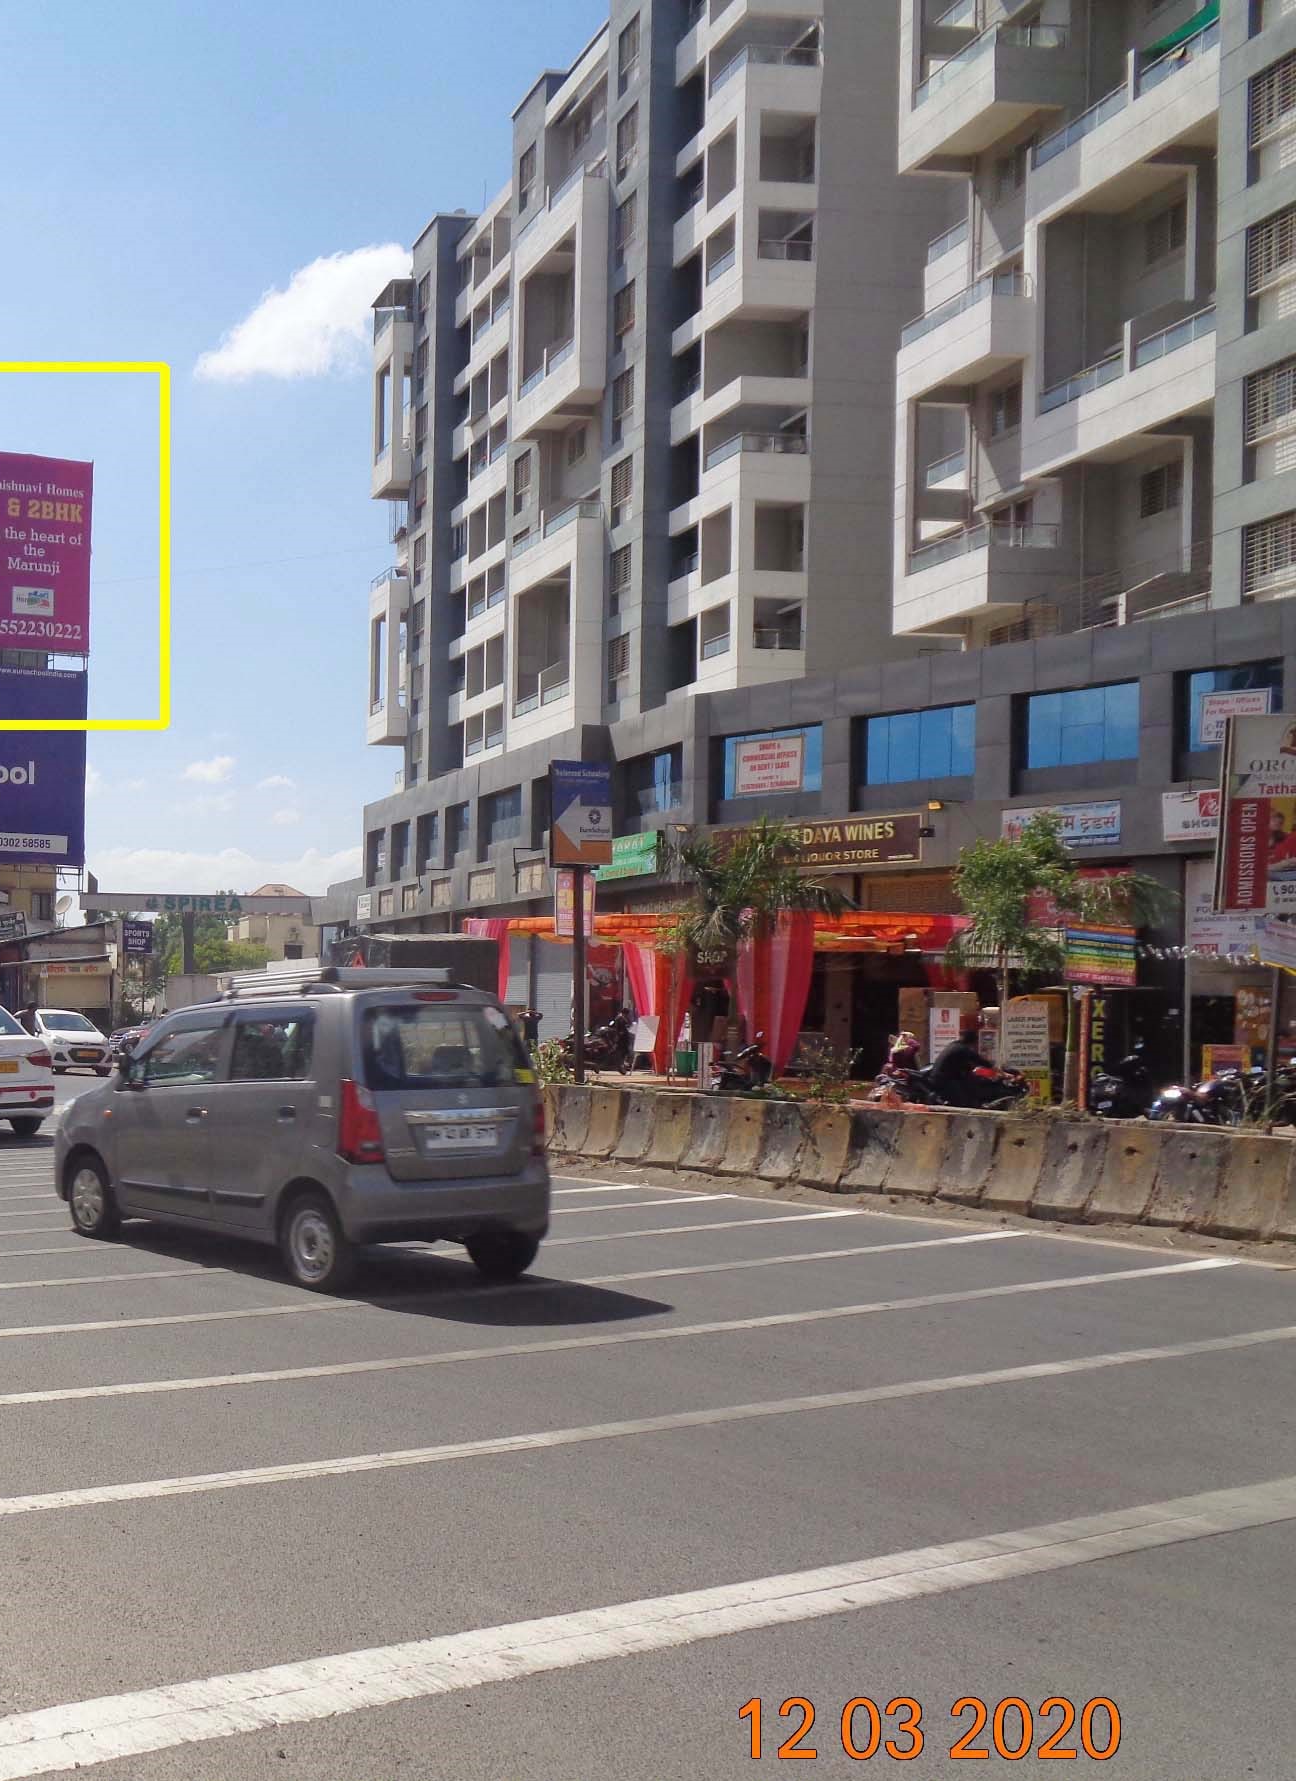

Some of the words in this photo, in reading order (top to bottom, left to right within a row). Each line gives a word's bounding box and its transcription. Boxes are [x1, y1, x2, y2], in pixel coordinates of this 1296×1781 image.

[47, 483, 84, 498] Homes
[27, 499, 83, 524] 2BHK
[5, 526, 26, 540] the
[31, 528, 65, 544] heart
[69, 533, 82, 545] of
[24, 543, 45, 556] the
[7, 557, 60, 576] Marunji
[1240, 803, 1259, 832] OPEN
[845, 821, 895, 841] WINES
[22, 838, 51, 849] 58585
[843, 848, 880, 860] STORE
[1236, 836, 1257, 905] ADMISSIONS
[124, 929, 150, 938] SPORTS
[128, 938, 147, 946] SHOP
